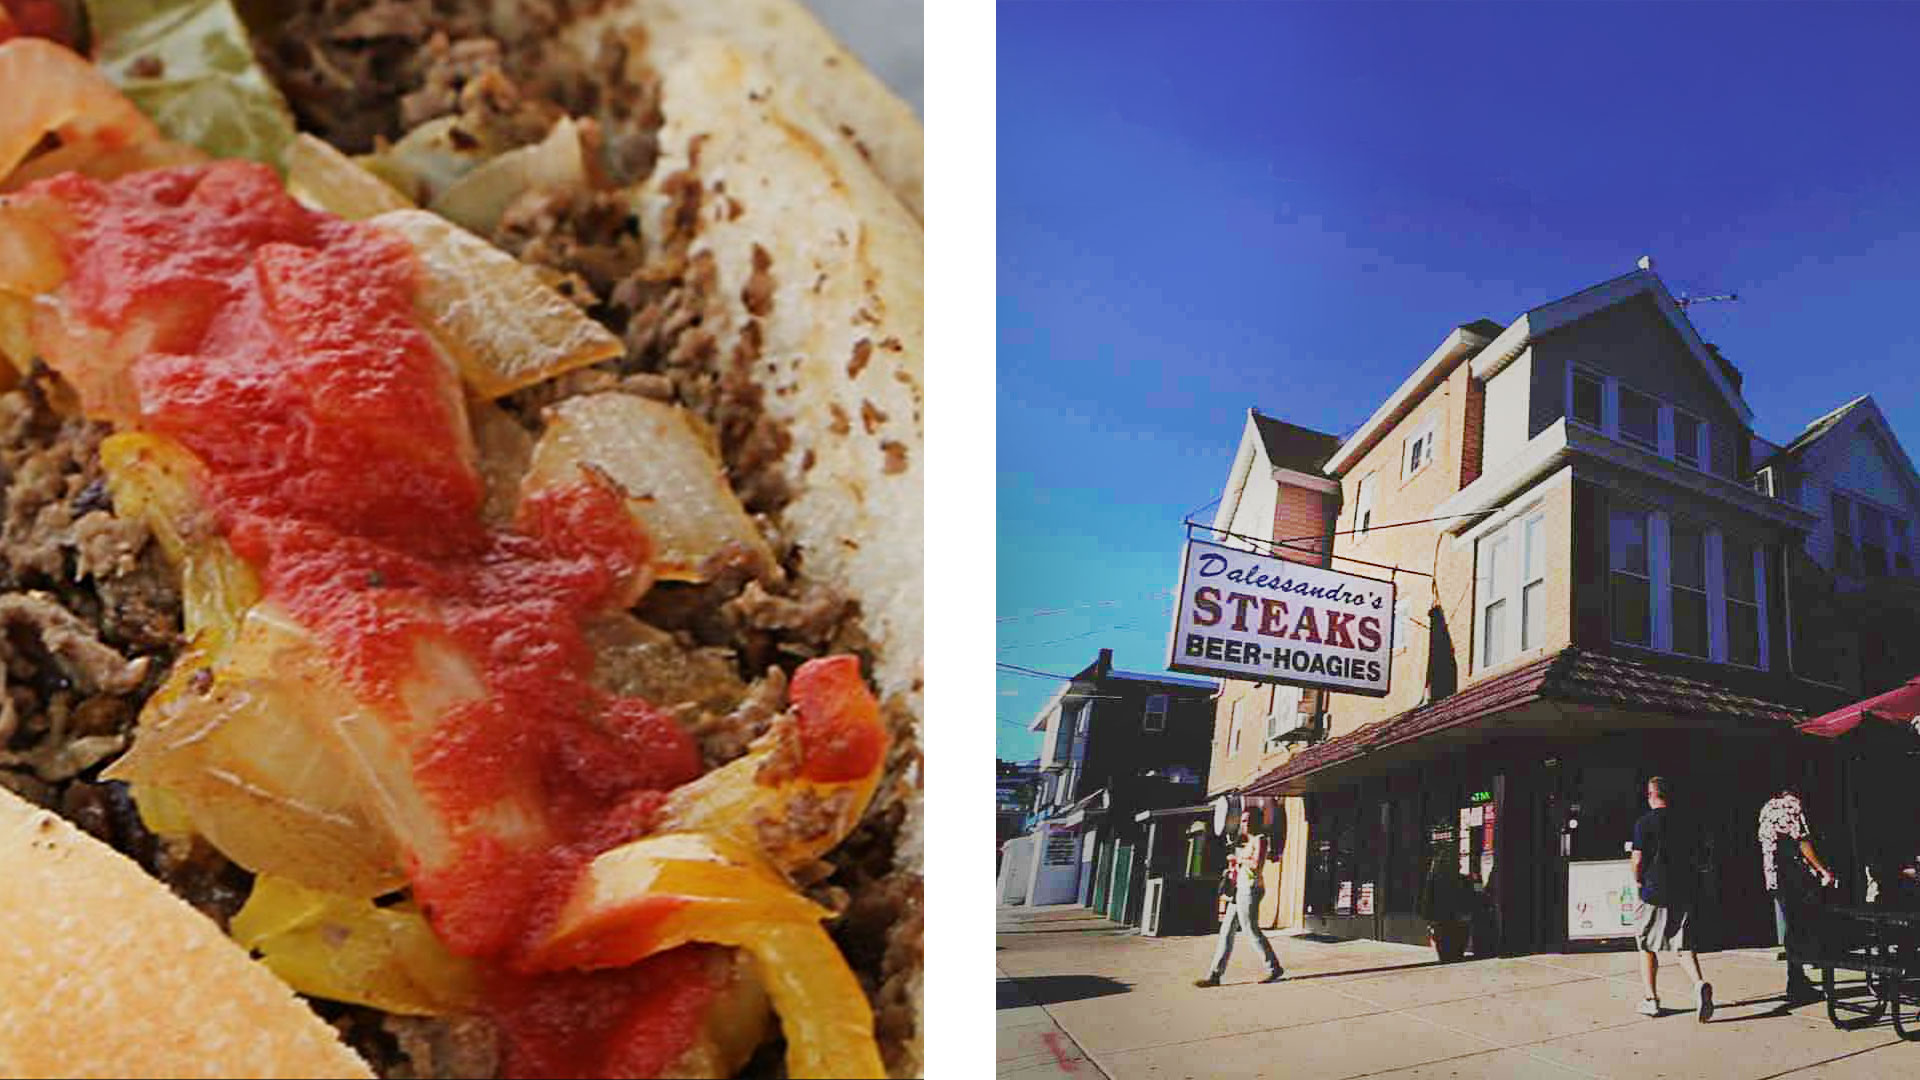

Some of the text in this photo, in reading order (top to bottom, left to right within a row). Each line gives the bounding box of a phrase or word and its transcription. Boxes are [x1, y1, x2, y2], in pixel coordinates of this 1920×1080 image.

[1199, 553, 1384, 609] Dalessandro's
[1194, 586, 1382, 652] STEAKS
[1185, 633, 1381, 681] BEER-HOAGIES
